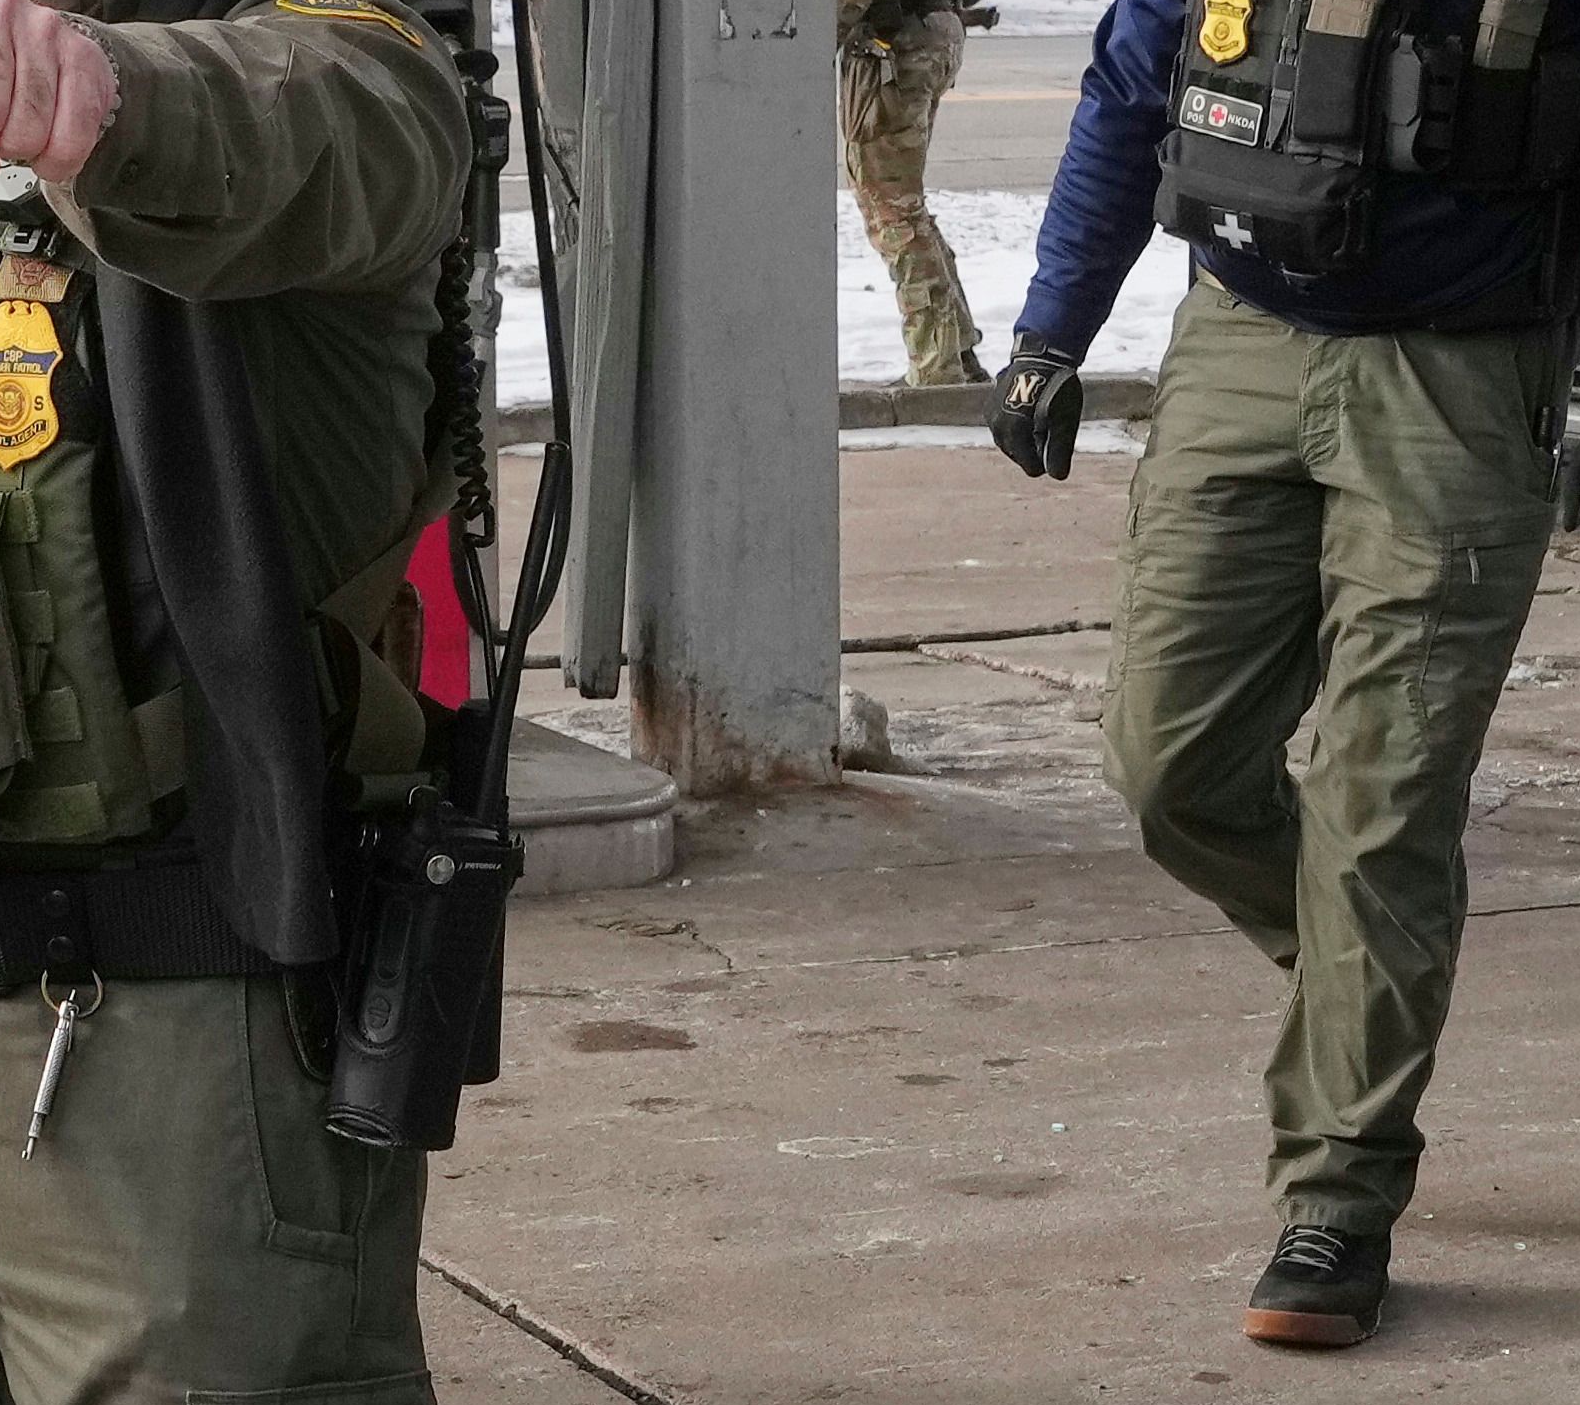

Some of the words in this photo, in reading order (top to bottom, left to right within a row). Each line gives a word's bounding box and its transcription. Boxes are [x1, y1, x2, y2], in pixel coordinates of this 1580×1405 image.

[1192, 94, 1206, 111] O
[1227, 113, 1255, 131] NKDA
[3, 349, 23, 362] CBP
[34, 396, 44, 411] S
[10, 420, 44, 446] AGENT
